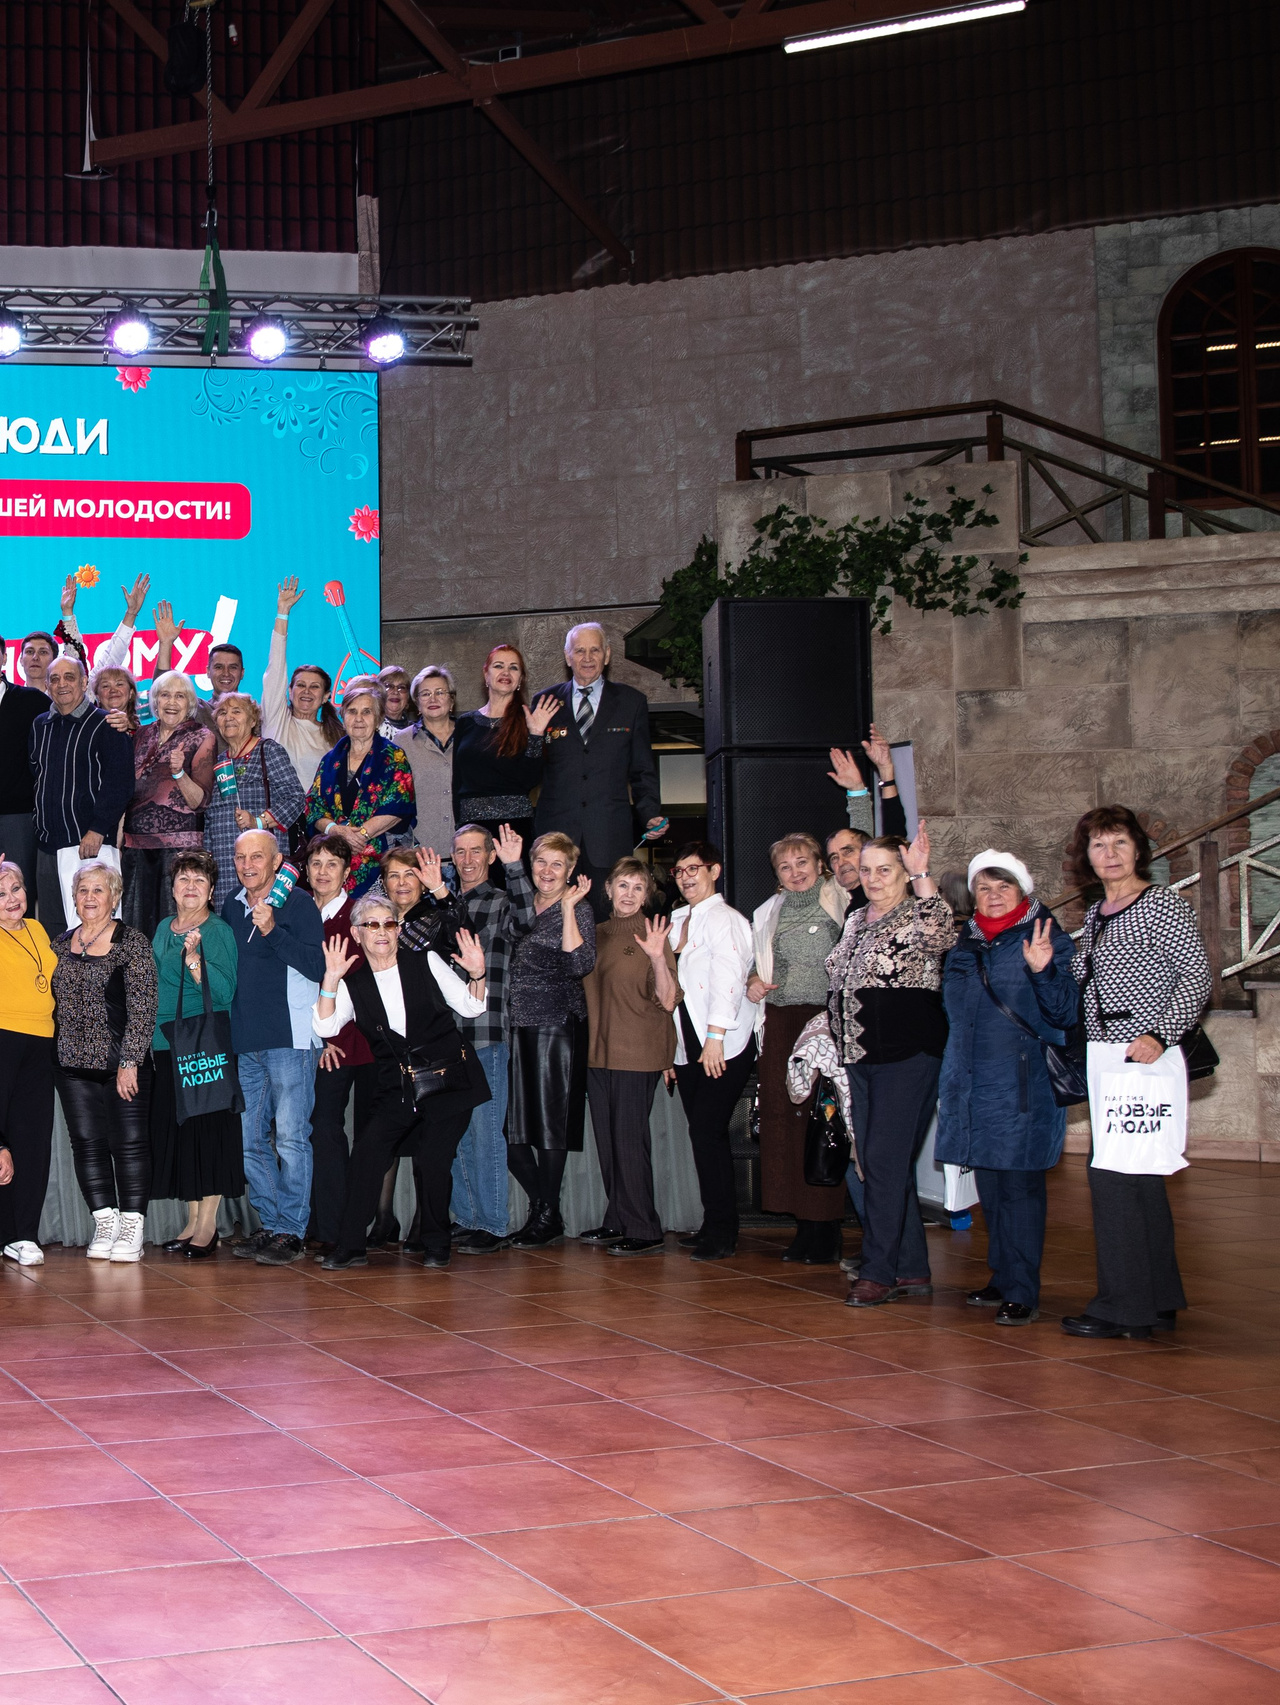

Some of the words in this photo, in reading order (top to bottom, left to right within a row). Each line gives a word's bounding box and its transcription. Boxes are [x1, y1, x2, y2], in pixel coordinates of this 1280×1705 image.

[53, 498, 232, 523] МОЛОДОСТИ!
[178, 1053, 229, 1075] НОВЫЕ
[181, 1067, 224, 1088] ЛЮДИ
